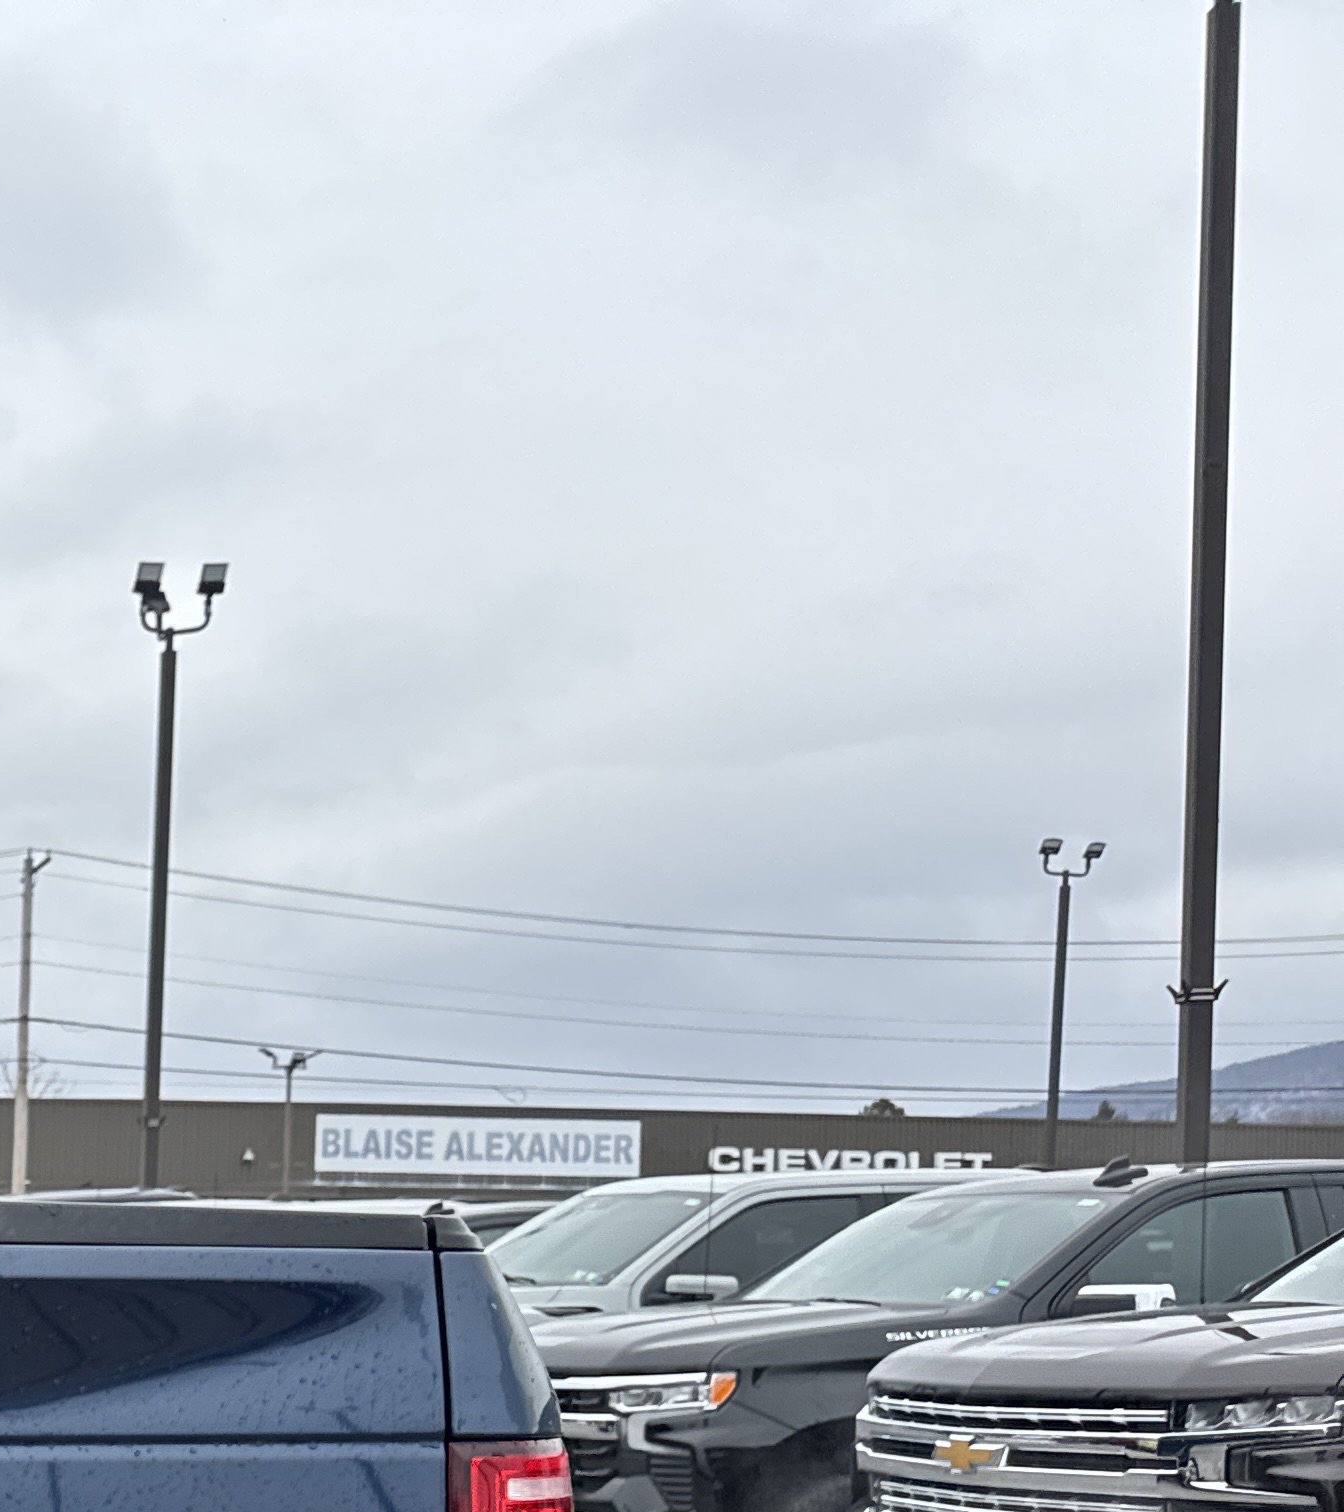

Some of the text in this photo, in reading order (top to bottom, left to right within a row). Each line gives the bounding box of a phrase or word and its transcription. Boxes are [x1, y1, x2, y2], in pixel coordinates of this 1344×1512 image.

[321, 1128, 634, 1165] BLAISE ALEXANDER
[708, 1146, 993, 1173] CHEVROLET
